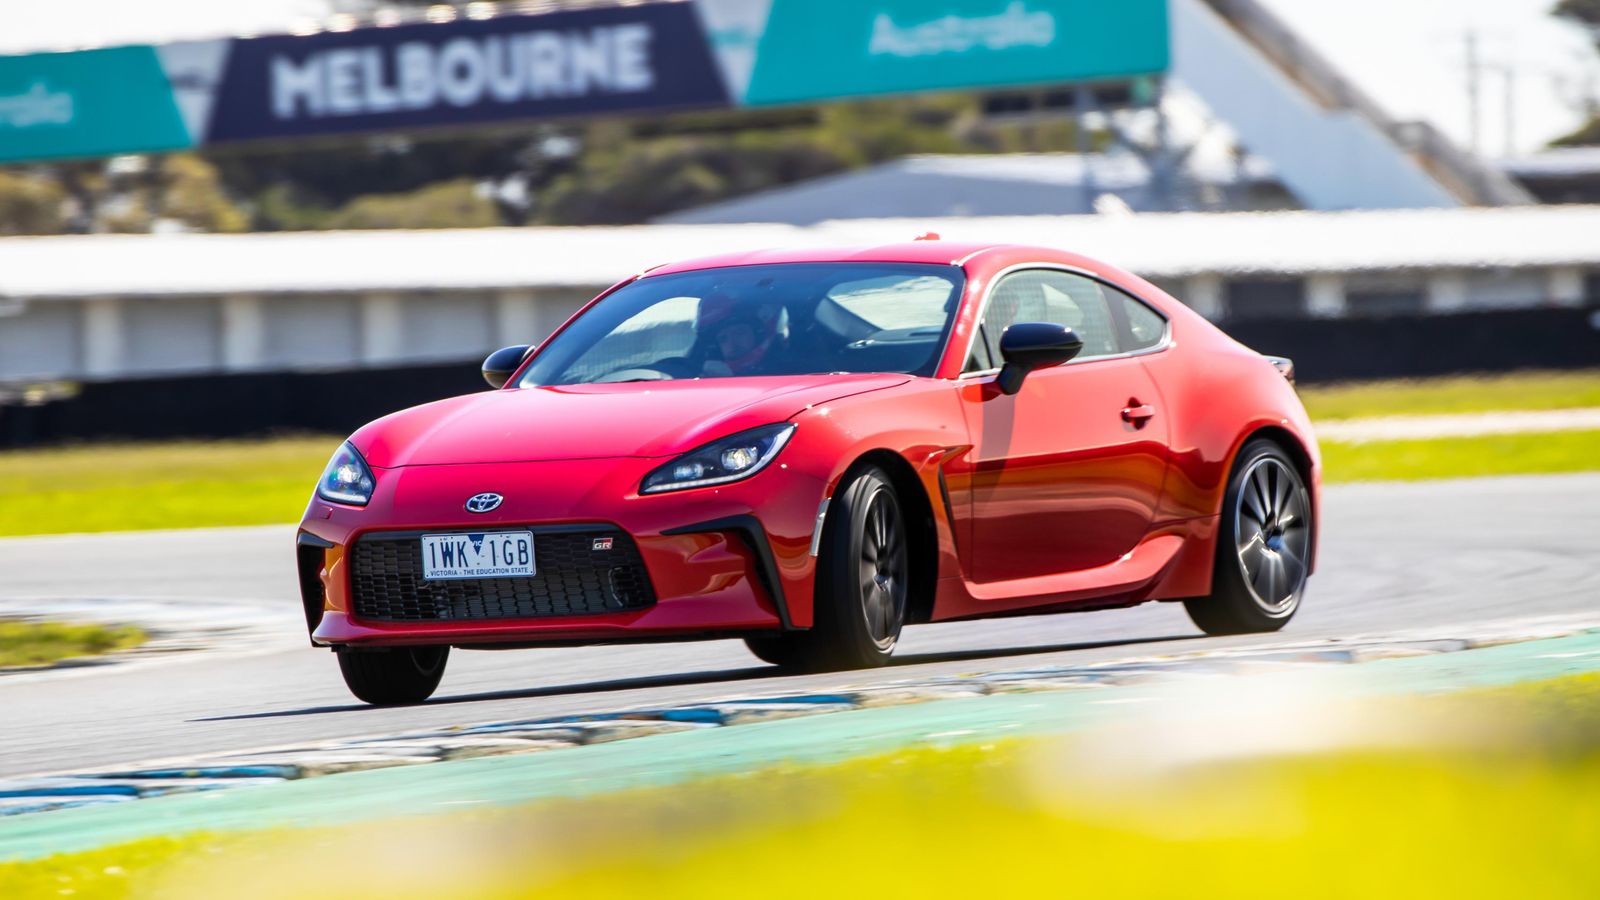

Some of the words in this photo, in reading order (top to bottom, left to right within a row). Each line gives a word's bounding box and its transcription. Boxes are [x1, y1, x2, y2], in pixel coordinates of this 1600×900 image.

[271, 23, 654, 118] MELBOURNE
[430, 541, 469, 569] 1WK
[490, 539, 529, 567] 1GB
